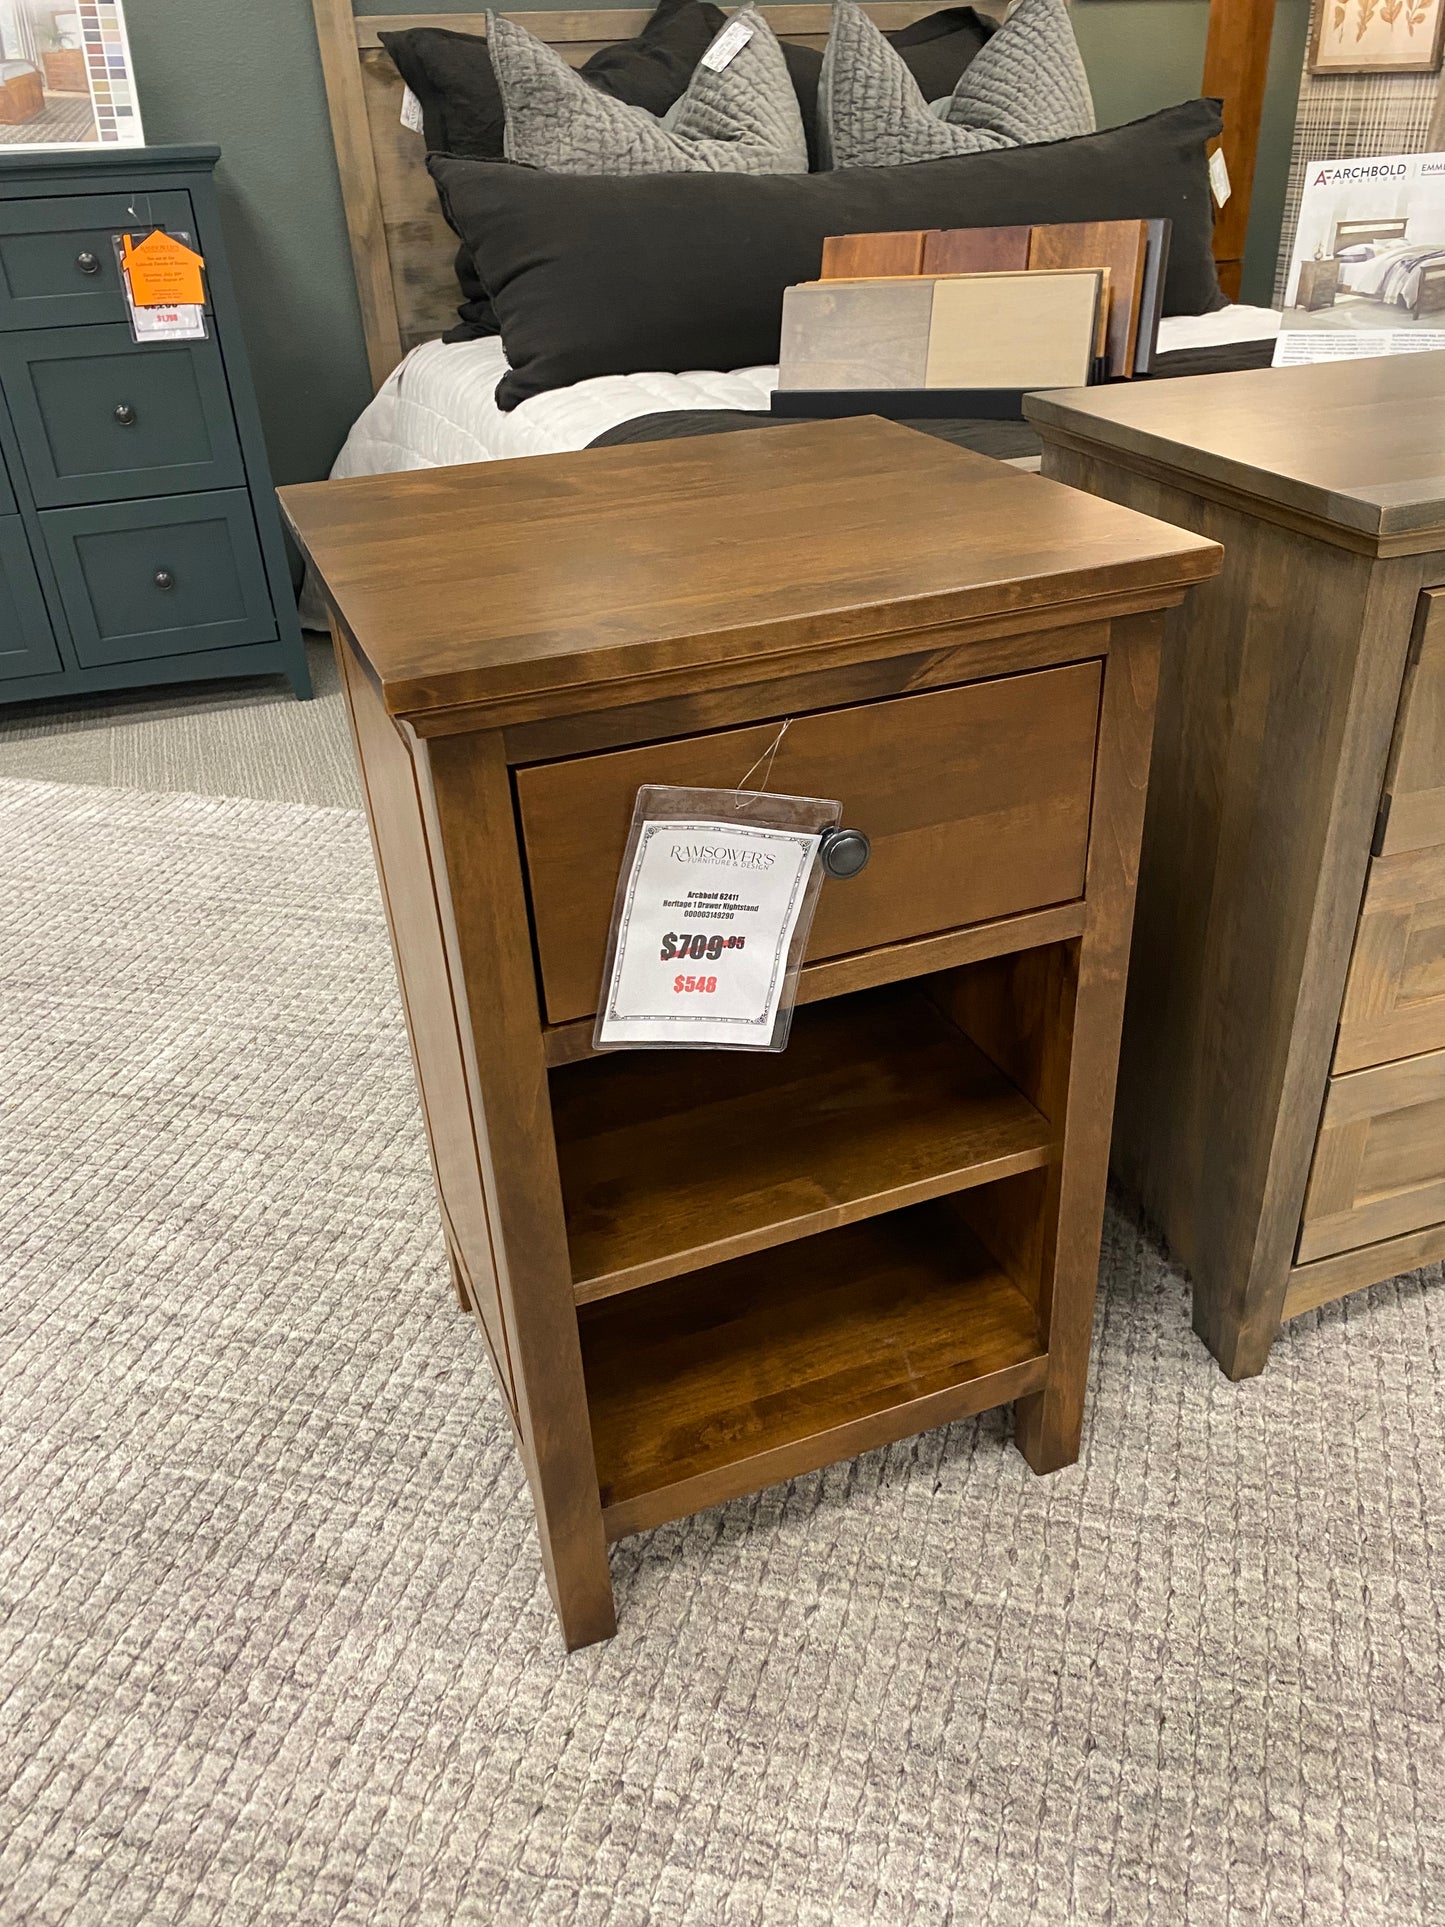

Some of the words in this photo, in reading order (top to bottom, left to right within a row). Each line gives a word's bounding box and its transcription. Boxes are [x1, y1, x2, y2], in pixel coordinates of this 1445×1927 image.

[1333, 164, 1407, 180] ARCHBOLD
[1421, 163, 1445, 171] EMM
[670, 845, 776, 866] RAMSOWER'S
[687, 858, 730, 867] FURNITURE
[741, 861, 769, 871] DESIGN
[687, 891, 718, 900] Archbold
[719, 893, 739, 901] 62411
[663, 900, 693, 909] Heritage
[693, 901, 697, 909] 1
[697, 902, 722, 910] Drawer
[722, 903, 759, 912] Nightstand
[673, 975, 717, 993] $548
